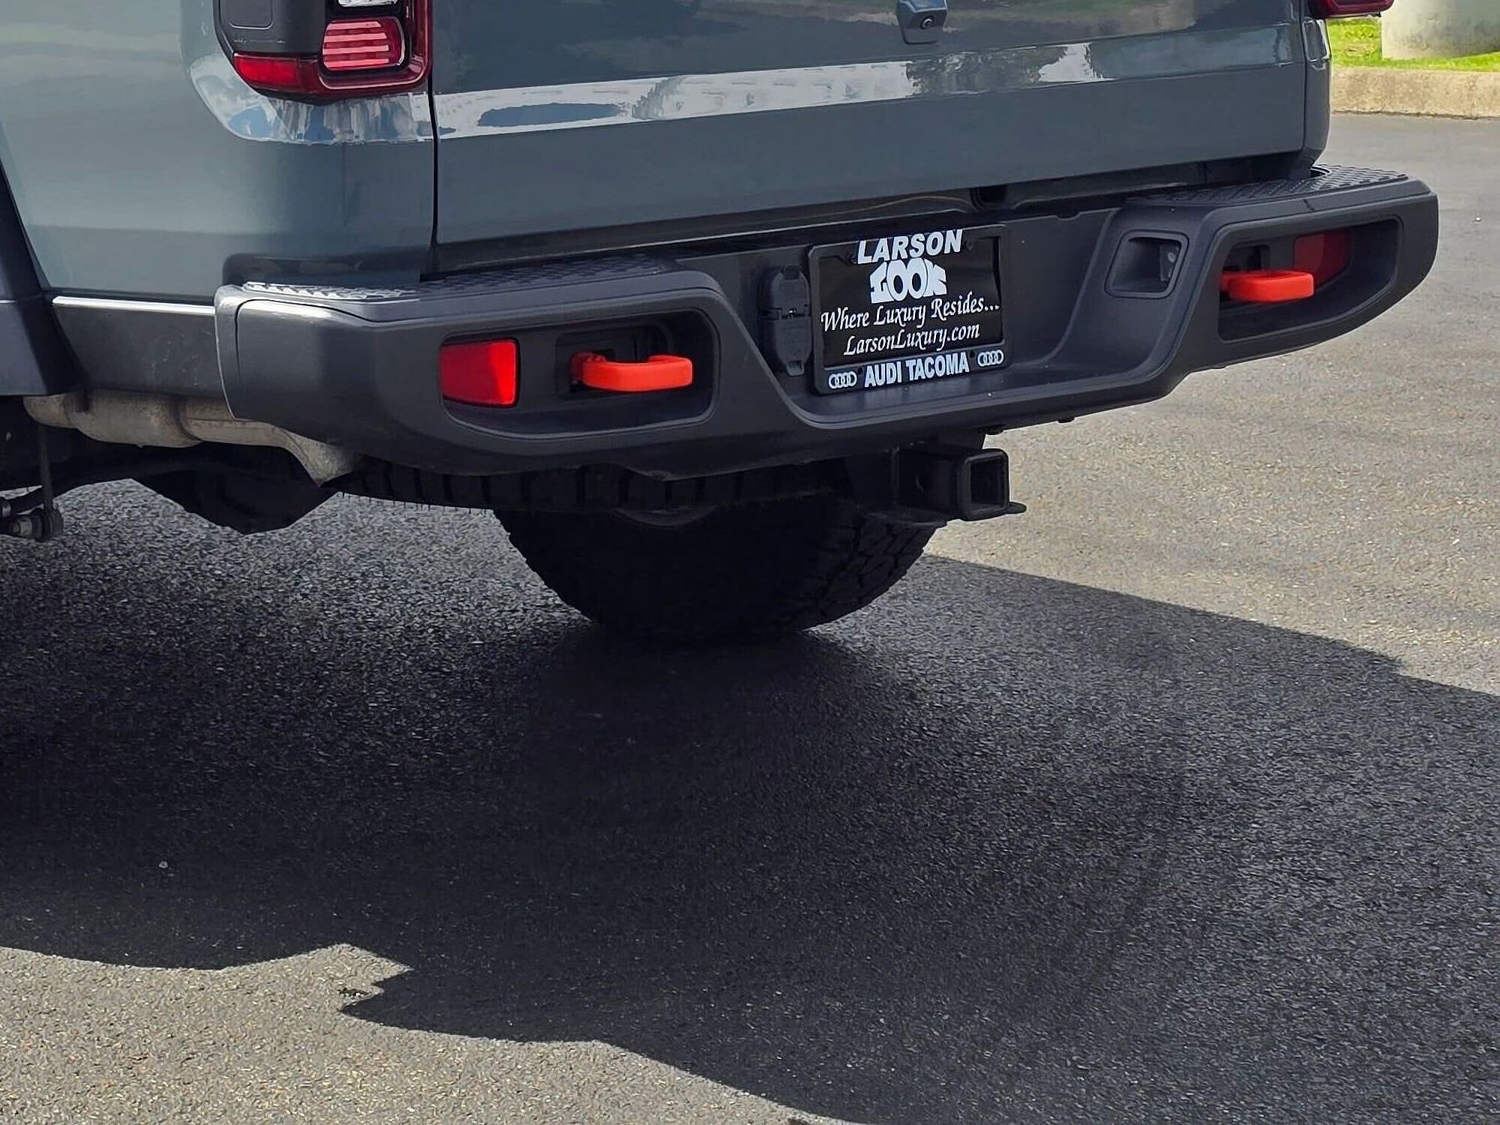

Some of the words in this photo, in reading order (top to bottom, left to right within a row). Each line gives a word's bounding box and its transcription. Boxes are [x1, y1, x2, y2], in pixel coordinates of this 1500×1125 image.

[857, 229, 963, 265] LARSON
[820, 306, 870, 332] Where
[873, 303, 927, 328] Luxury
[930, 291, 1000, 320] Resides...
[843, 323, 980, 357] LarsonLuxury.com
[864, 365, 902, 389] AUDI
[905, 352, 970, 382] TACOMA
